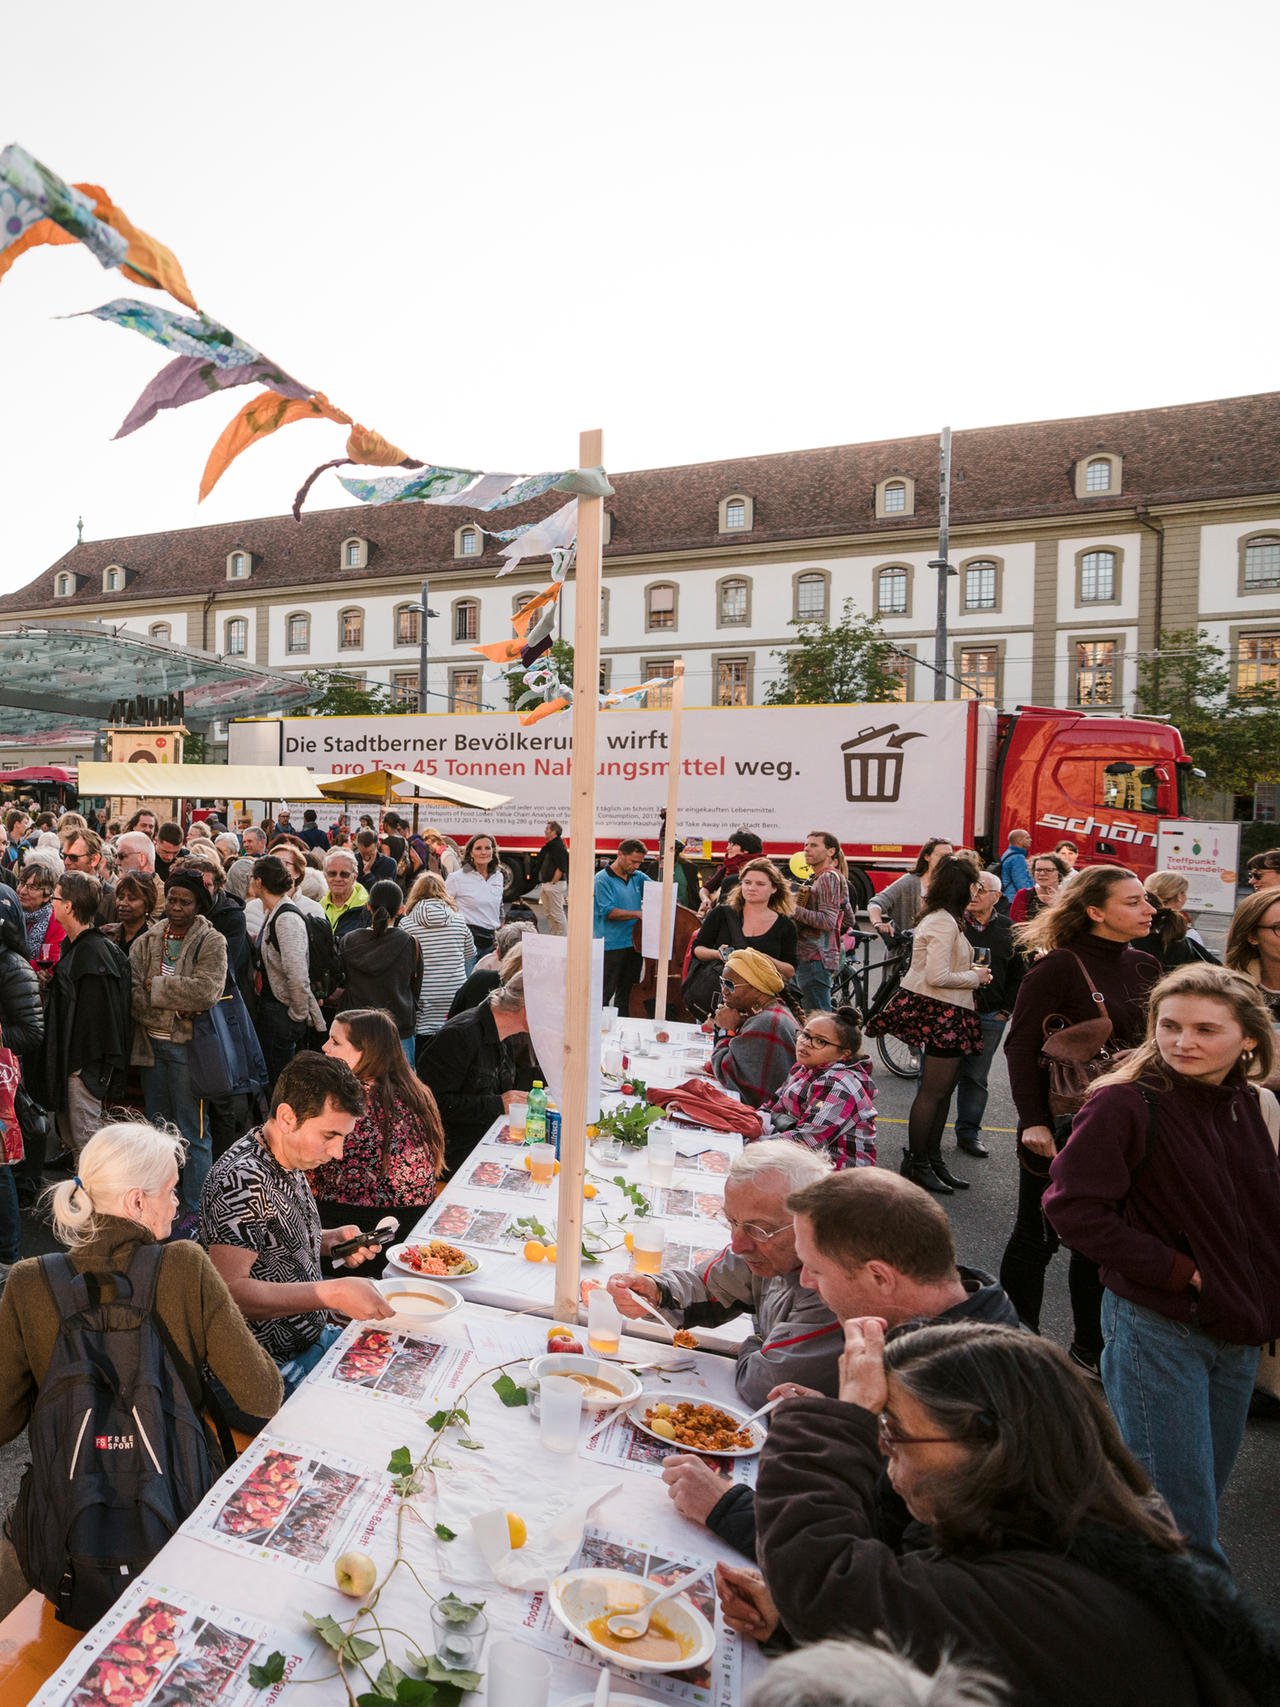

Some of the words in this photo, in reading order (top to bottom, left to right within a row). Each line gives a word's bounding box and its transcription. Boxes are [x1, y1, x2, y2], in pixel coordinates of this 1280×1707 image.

[286, 737, 317, 753] Die
[323, 735, 447, 752] Stadtberner
[607, 730, 668, 749] wirft
[331, 763, 365, 775] pro
[411, 760, 438, 776] 45
[445, 759, 528, 776] Tonnen
[735, 761, 801, 781] weg.
[1167, 856, 1216, 865] Treffpunkt
[95, 1438, 107, 1448] FS
[107, 1442, 133, 1450] SPORT
